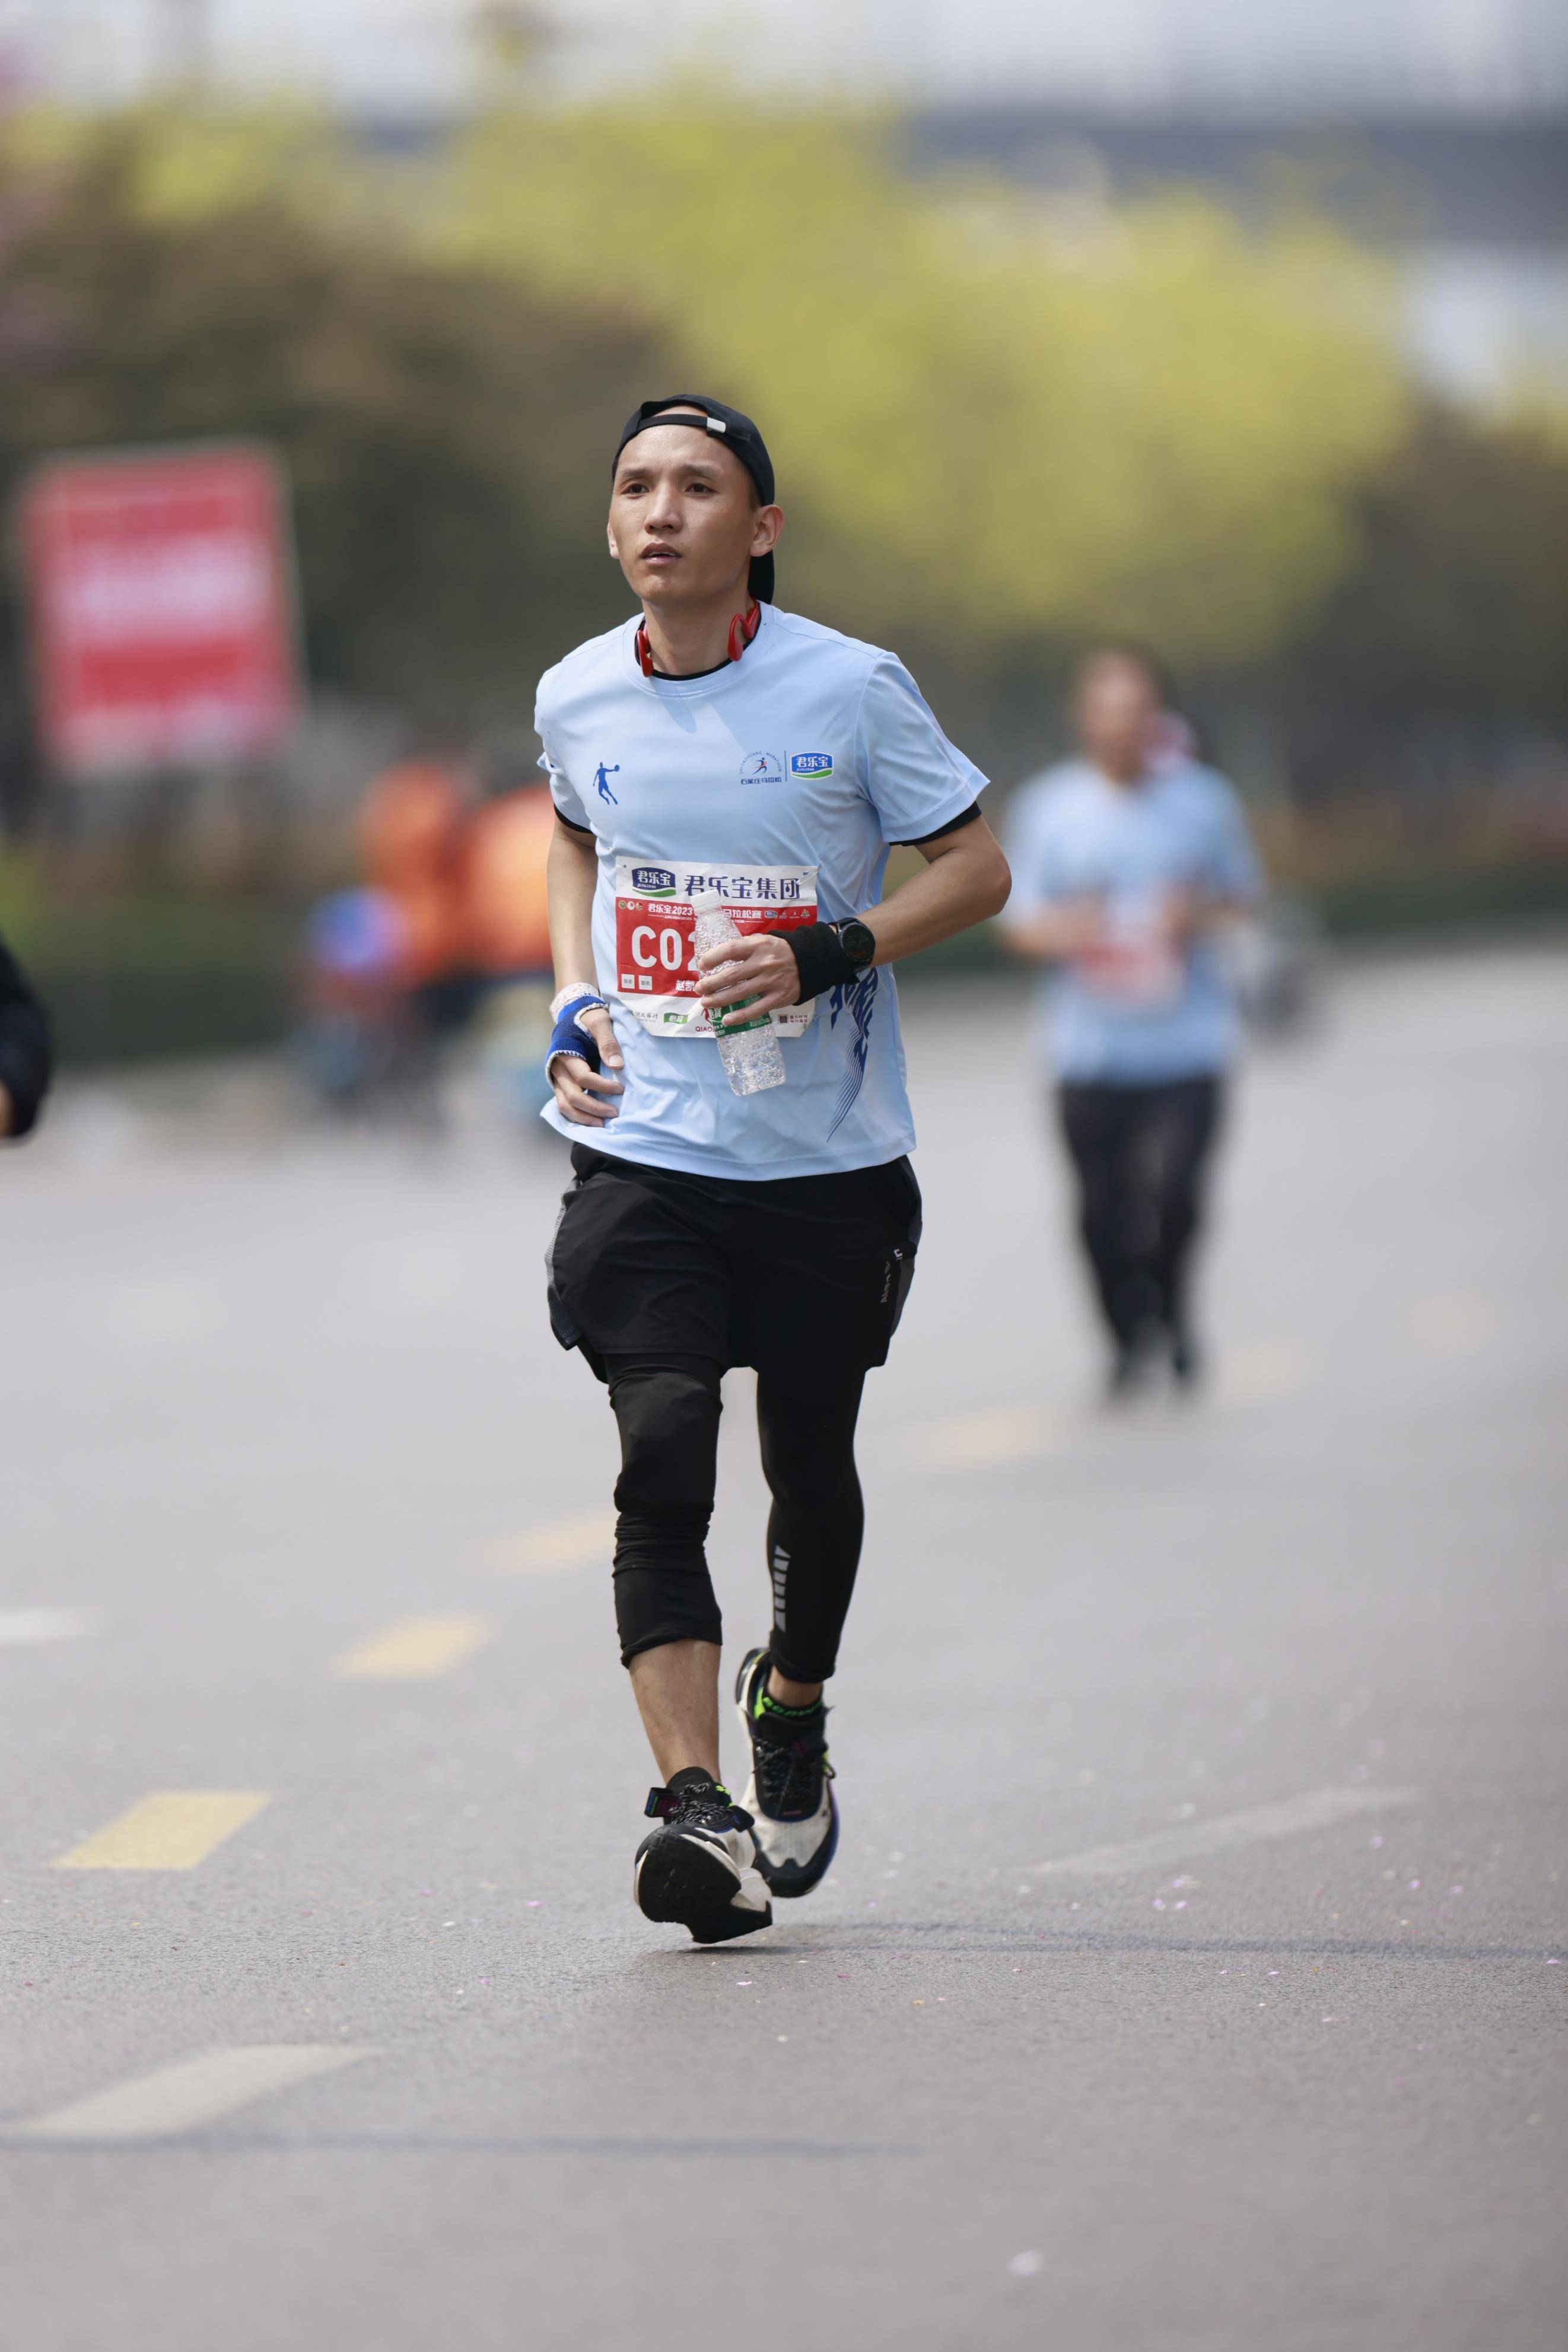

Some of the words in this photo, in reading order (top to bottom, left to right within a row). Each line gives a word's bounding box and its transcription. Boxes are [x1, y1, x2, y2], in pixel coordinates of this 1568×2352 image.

[796, 756, 829, 768] 君乐宝
[740, 776, 783, 785] 石家庄马拉松
[637, 870, 671, 886] 君乐宝
[683, 875, 800, 901] 君乐宝集团
